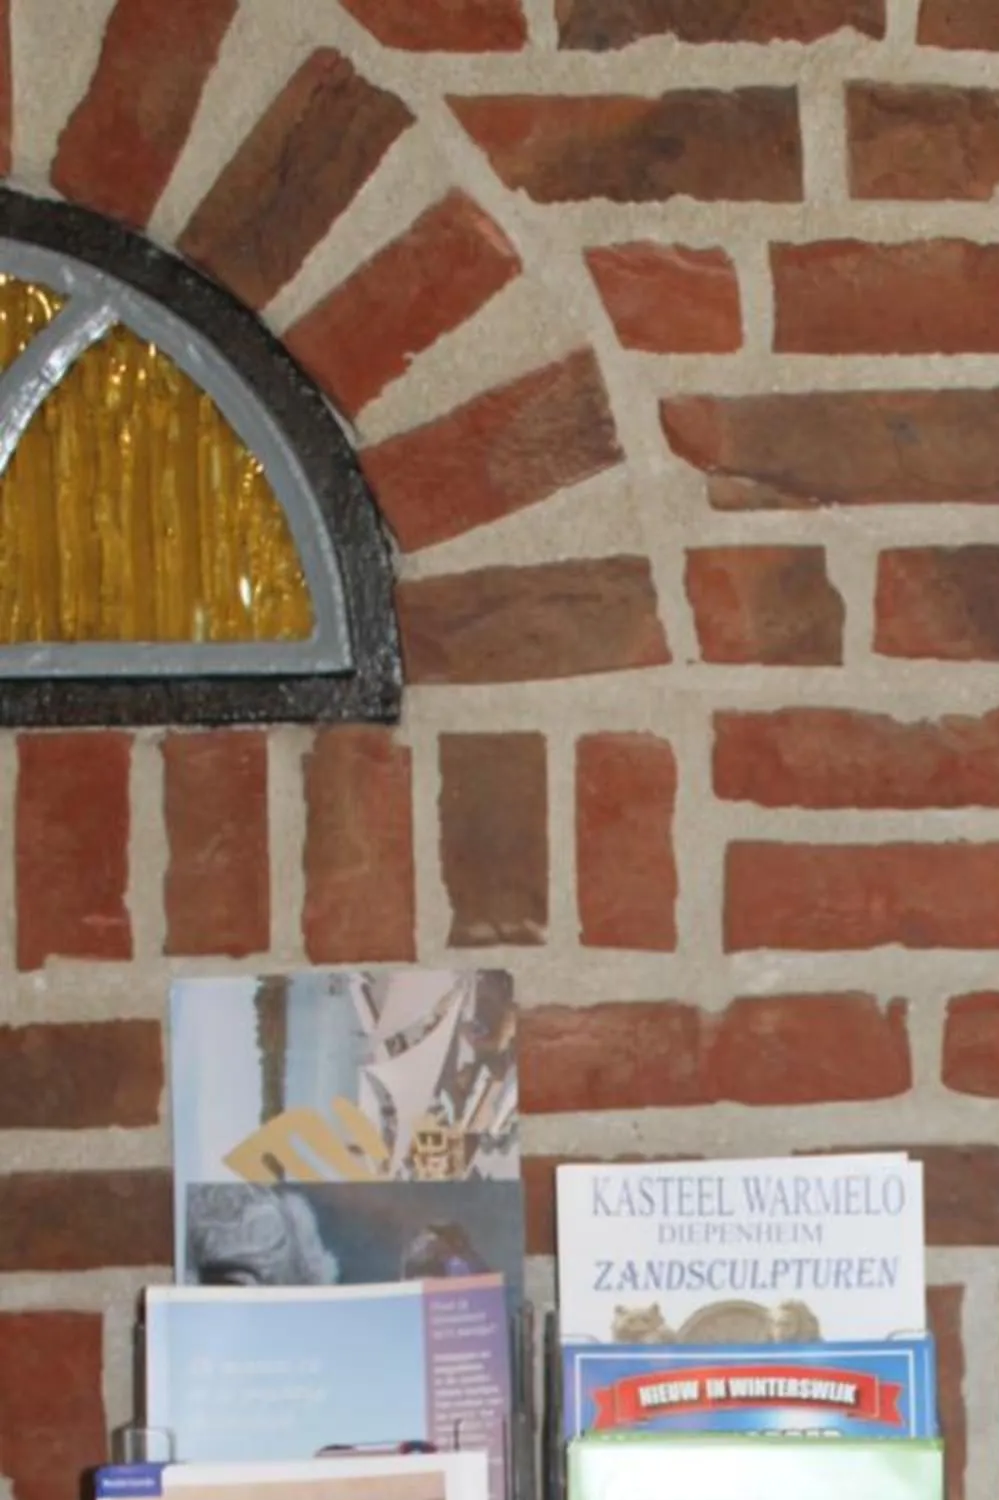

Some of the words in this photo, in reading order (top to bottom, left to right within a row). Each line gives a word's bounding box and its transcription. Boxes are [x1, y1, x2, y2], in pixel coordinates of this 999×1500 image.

[592, 1175, 735, 1218] KASTEEL
[742, 1173, 906, 1217] WARMELO
[657, 1221, 825, 1246] DIEPENHEIM
[592, 1256, 901, 1292] ZANDSCULPTUREN
[639, 1379, 699, 1407] NIEUW
[705, 1377, 727, 1400] IN
[728, 1376, 858, 1405] WINTERSWIJK
